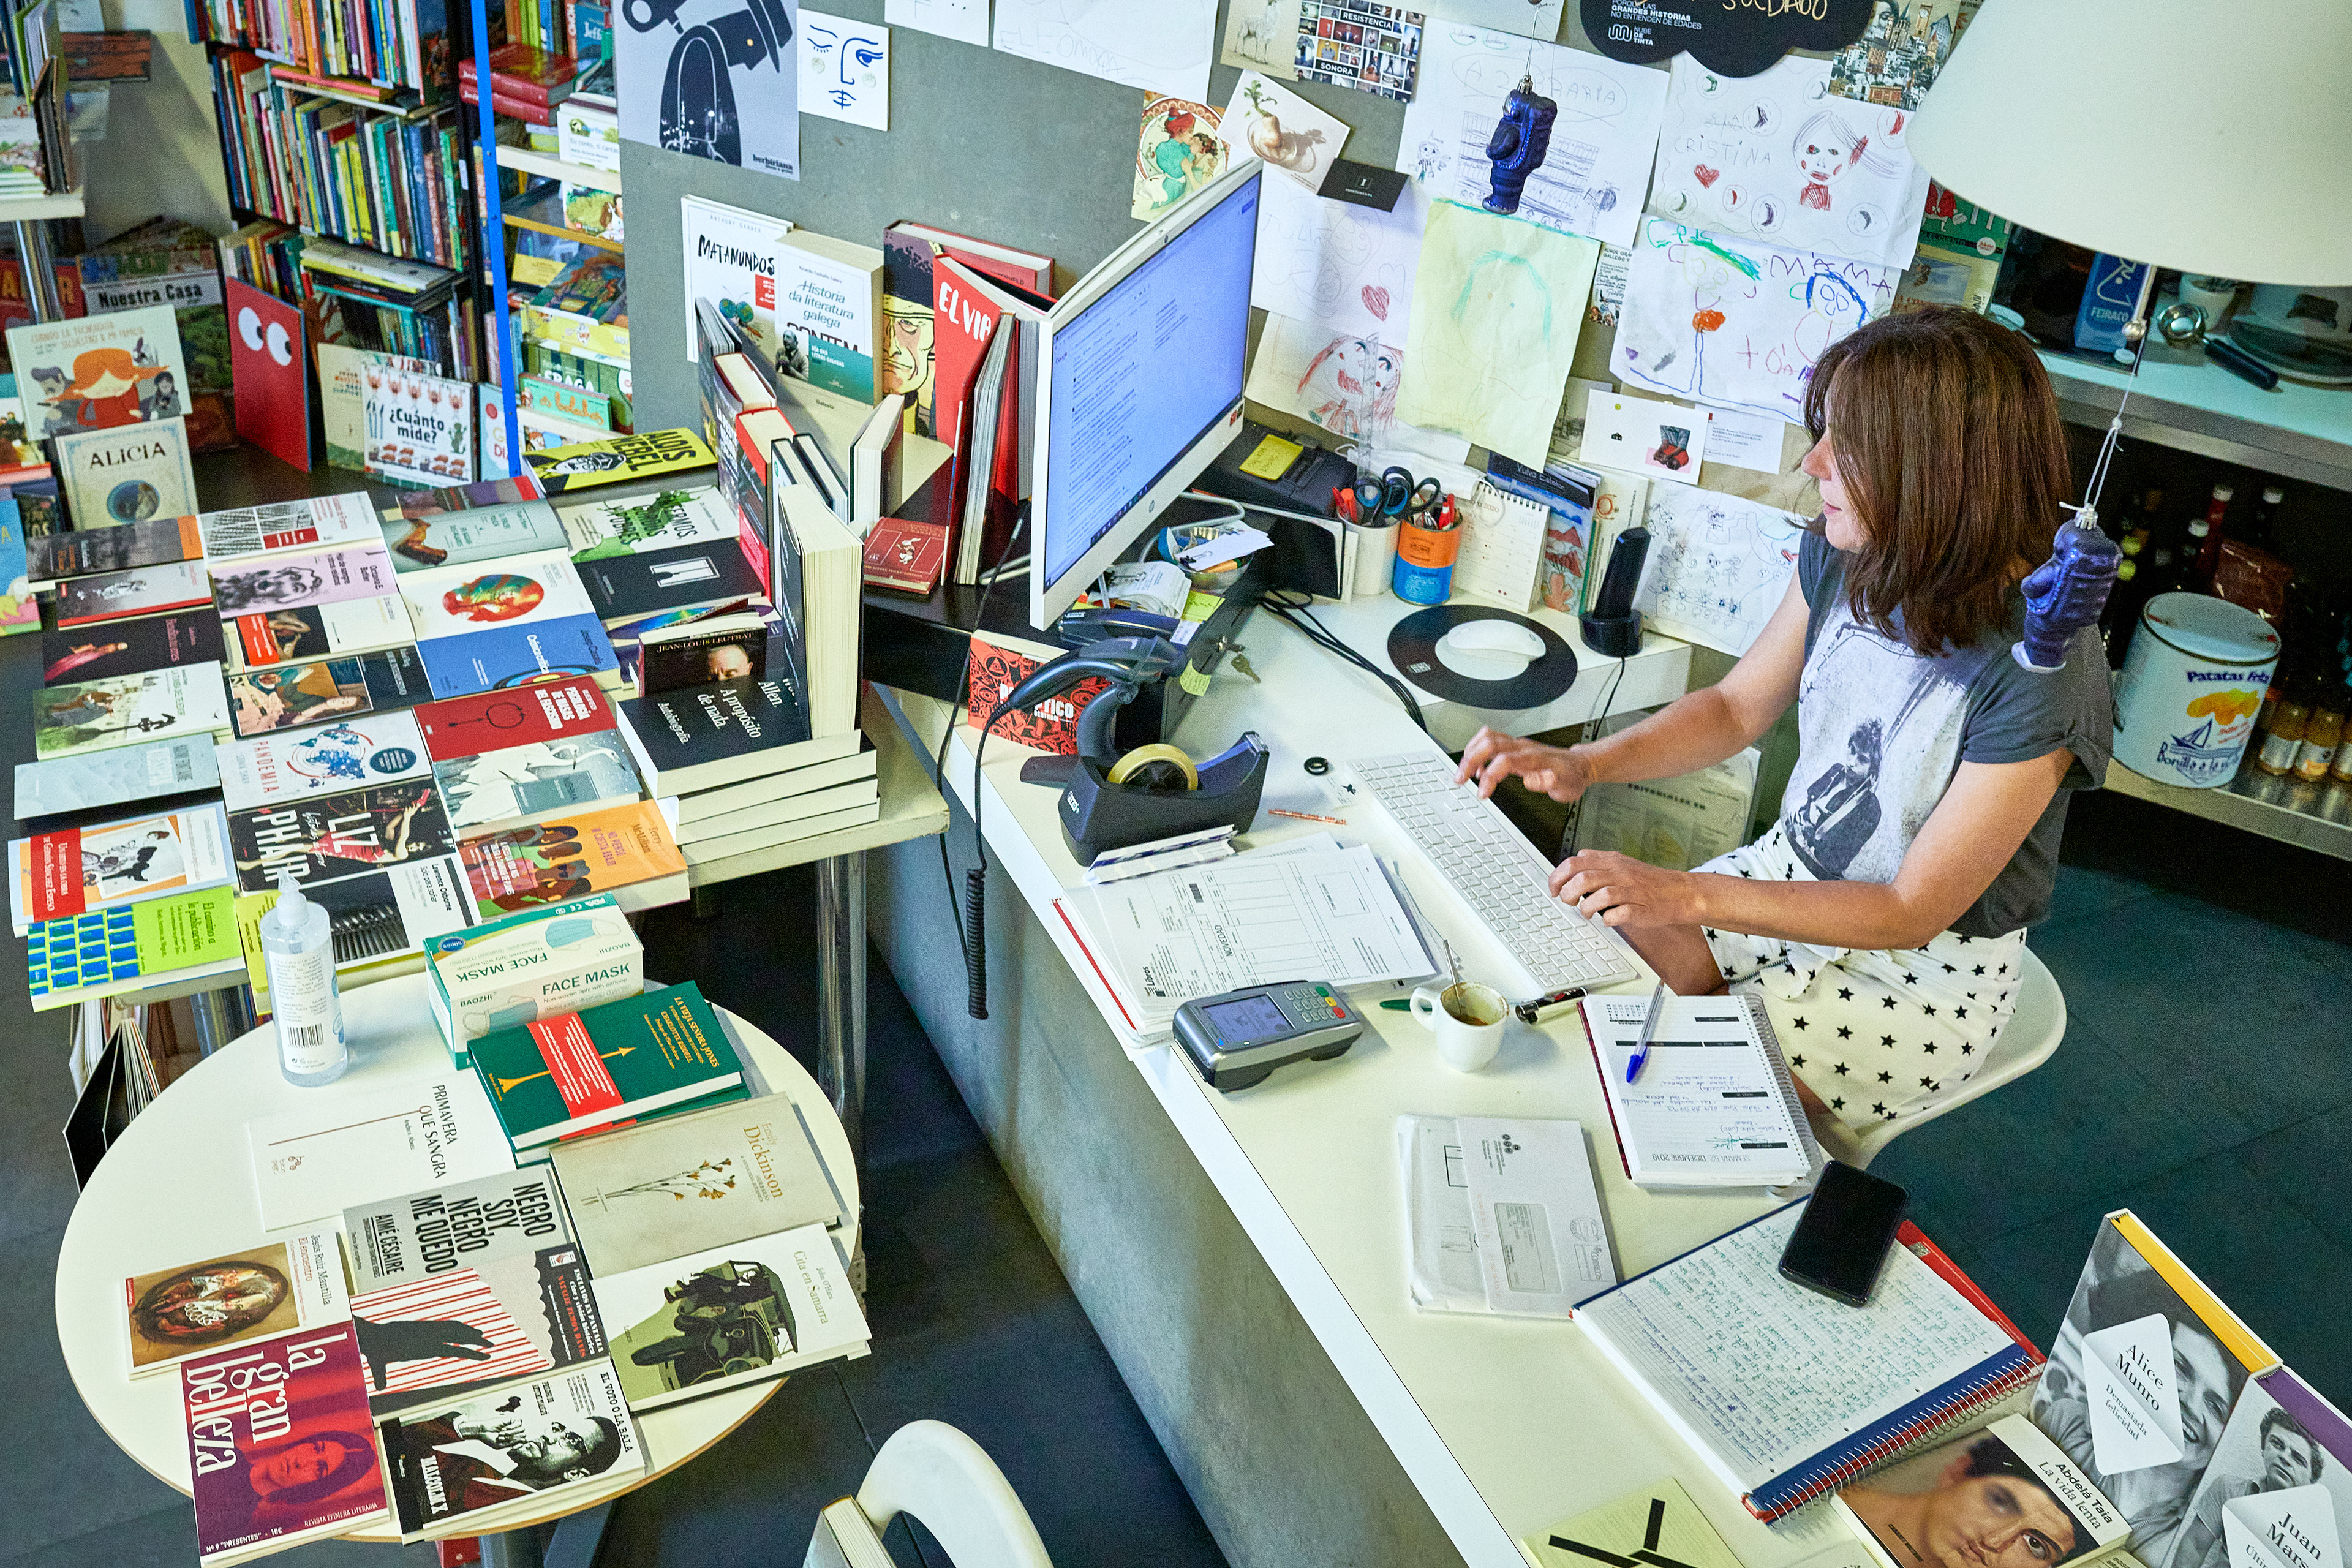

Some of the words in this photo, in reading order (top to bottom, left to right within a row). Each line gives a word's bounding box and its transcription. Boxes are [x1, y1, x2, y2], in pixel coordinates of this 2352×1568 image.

[1343, 12, 1392, 29] RESISTENCIA
[1612, 6, 1648, 15] GRANDES
[1649, 10, 1691, 20] HISTORIAS
[1620, 13, 1661, 23] ENTIENDEN
[1673, 18, 1702, 29] EDADES
[1320, 62, 1354, 75] SONORA
[753, 154, 793, 170] berbiriana
[698, 234, 775, 276] MATAMUNDOS
[98, 285, 161, 308] Nuestra
[165, 281, 203, 299] Casa
[788, 292, 802, 301] da
[804, 295, 853, 320] literatura
[797, 281, 845, 303] Historia
[802, 309, 840, 328] galega
[939, 281, 959, 324] EL
[963, 299, 992, 341] VIA
[389, 405, 445, 431] ¿Cuánto
[397, 423, 437, 444] mide?
[646, 431, 697, 461] ALOIS
[89, 442, 167, 469] ALICIA
[611, 437, 660, 472] NEBEL
[526, 632, 543, 656] Crónica
[535, 653, 551, 675] crítica
[2187, 671, 2243, 682] Patatas
[534, 688, 548, 700] DEL
[551, 689, 564, 700] DE
[564, 685, 592, 720] PSICOLOGÍA
[696, 690, 715, 706] de
[720, 684, 737, 698] A
[757, 677, 786, 708] Allen.
[539, 697, 563, 731] FASCISMO
[555, 697, 575, 722] MASAS
[703, 701, 730, 730] nada.
[722, 692, 764, 741] propósito
[252, 741, 279, 793] PANDEMIA
[2157, 742, 2196, 770] Bonilla
[249, 809, 311, 884] PHAIR
[327, 812, 379, 854] LIZ
[420, 865, 429, 876] Solo
[422, 876, 432, 889] para
[428, 888, 439, 903] soñar
[431, 863, 445, 888] Lawrence
[439, 887, 453, 911] Osborne
[202, 902, 214, 910] El
[184, 909, 205, 951] publicación
[203, 910, 217, 937] camino
[1214, 924, 1234, 957] NOVEDAD
[455, 962, 504, 984] MASK
[507, 950, 548, 970] FACE
[540, 975, 582, 996] FACE
[583, 962, 631, 984] MASK
[1141, 965, 1155, 987] Libros
[673, 995, 684, 1006] LA
[677, 1004, 694, 1024] VIEJA
[687, 1020, 709, 1048] SEÑORA
[699, 1044, 720, 1068] JONES
[418, 1104, 435, 1129] QUE
[432, 1084, 459, 1145] PRIMAVERA
[761, 1121, 778, 1147] Emily
[424, 1130, 447, 1177] SANGRA
[742, 1123, 787, 1199] Dickinson
[409, 1194, 445, 1220] ME
[481, 1197, 520, 1237] SOY,
[513, 1182, 556, 1237] NEGRO
[374, 1212, 399, 1237] AIMÉ
[445, 1196, 490, 1254] NEGRO
[309, 1234, 323, 1253] Jesús
[379, 1234, 407, 1275] CÉSAIRE
[414, 1218, 458, 1275] QUEDO
[300, 1245, 315, 1282] encuentro
[314, 1253, 326, 1270] Ruiz
[792, 1249, 810, 1272] Cita
[815, 1266, 826, 1281] John
[317, 1270, 333, 1306] Mantilla
[568, 1280, 579, 1295] Cine
[573, 1268, 590, 1304] ESCLAVOS
[801, 1271, 812, 1285] en
[557, 1275, 572, 1305] NATALIE
[565, 1305, 579, 1332] ZEMON
[573, 1332, 586, 1355] DAVIS
[575, 1301, 588, 1321] visión
[584, 1303, 593, 1314] EN
[806, 1283, 830, 1325] Samarra
[581, 1321, 597, 1354] histórica
[587, 1314, 605, 1353] PANTALLA
[286, 1331, 349, 1372] la
[600, 1371, 611, 1383] EL
[2125, 1343, 2165, 1390] Alice
[604, 1383, 618, 1405] VOTO
[2114, 1352, 2162, 1411] Munro
[230, 1351, 291, 1444] gran
[2104, 1384, 2149, 1436] Demasiada
[186, 1366, 247, 1477] belleza
[614, 1413, 625, 1426] LA
[2104, 1399, 2140, 1441] felicidad
[618, 1427, 633, 1453] BALA
[420, 1455, 447, 1506] MALCOLM
[2037, 1459, 2056, 1478] La
[2052, 1476, 2078, 1501] vida
[2075, 1499, 2103, 1529] lenta
[2054, 1460, 2093, 1500] Abdelá
[304, 1515, 326, 1527] REVISTA
[350, 1501, 378, 1515] LITERARIA
[2277, 1511, 2328, 1561] Juan
